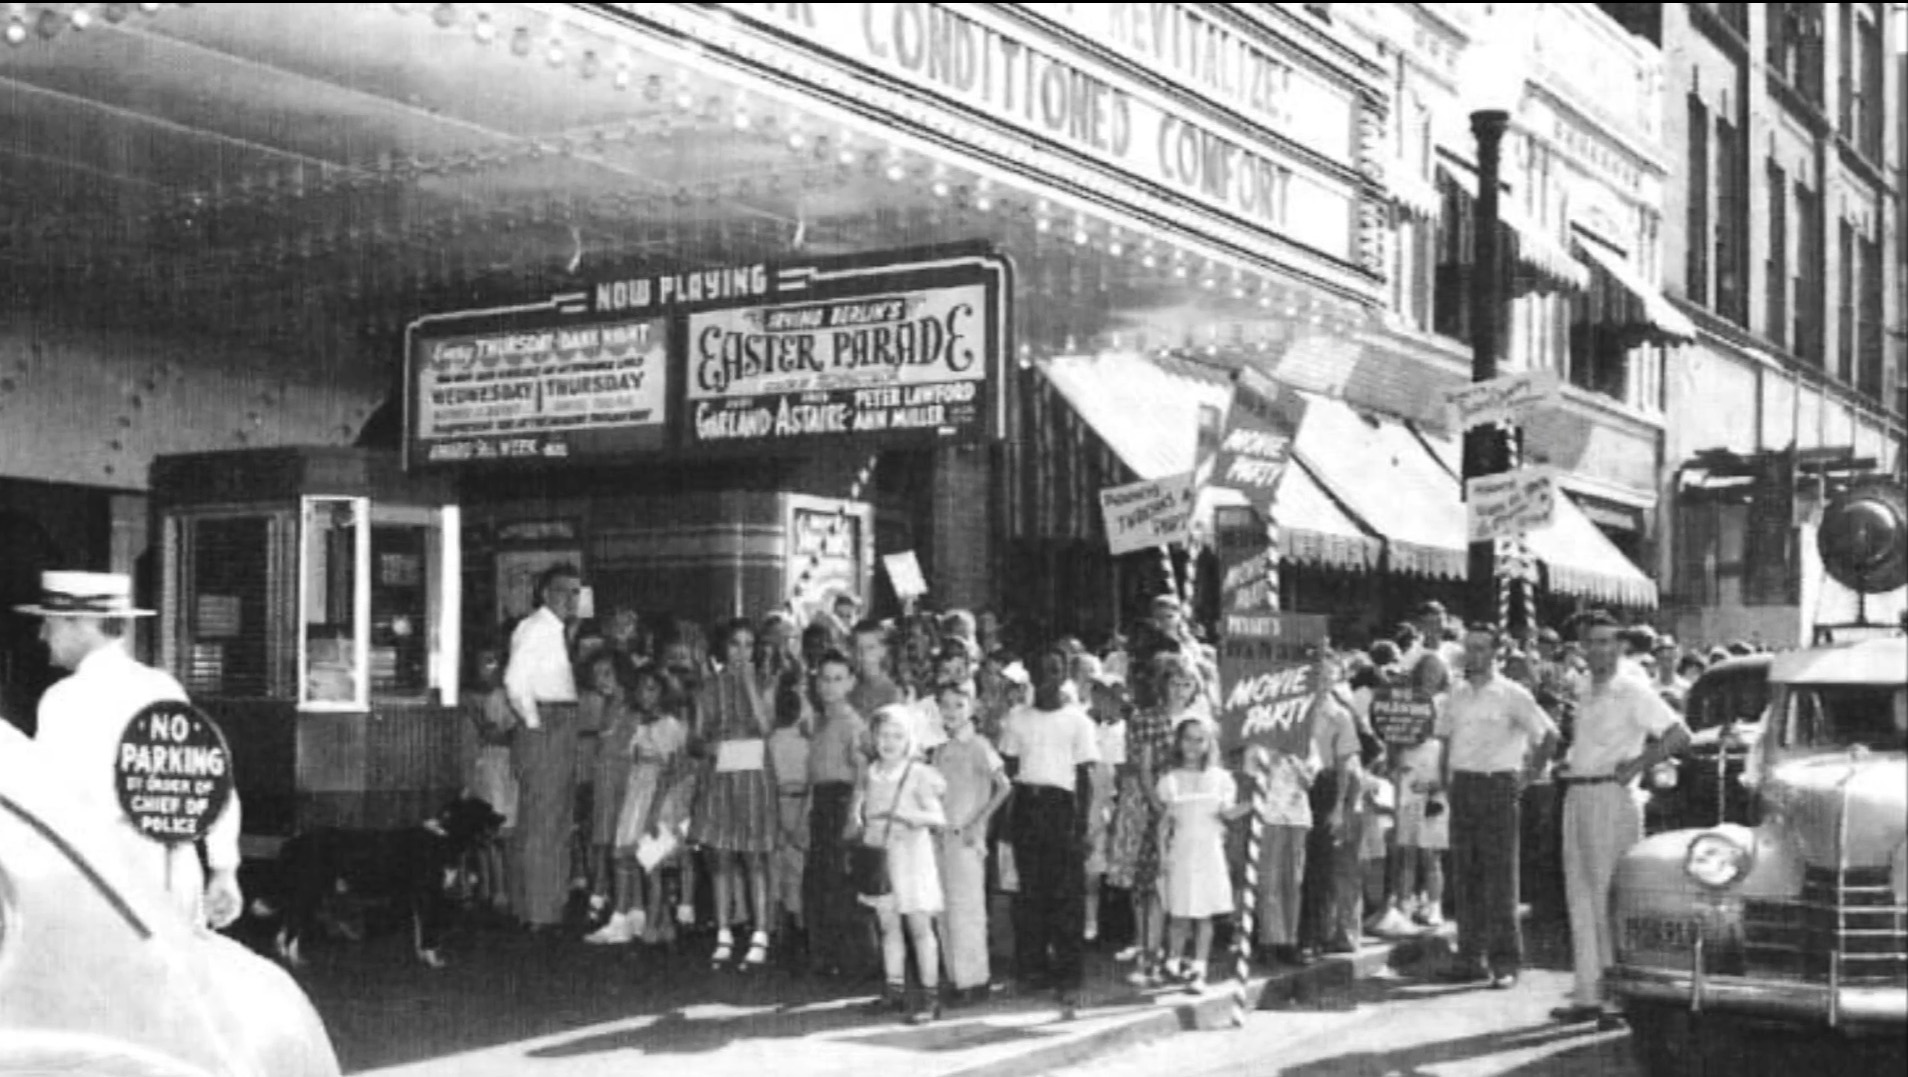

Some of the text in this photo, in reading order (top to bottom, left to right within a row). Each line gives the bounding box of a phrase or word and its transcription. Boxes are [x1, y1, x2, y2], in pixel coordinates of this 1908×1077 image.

[862, 4, 1293, 227] CONDITIONED COMFORT
[597, 264, 767, 311] NOW PLAYING
[699, 303, 974, 394] EASTER PARADE
[432, 382, 532, 405] WEDNESDAY
[546, 371, 645, 397] THURSDAY
[855, 388, 901, 408] PETER
[904, 381, 977, 406] LAWFORD
[1221, 428, 1290, 459] MOVIE
[1226, 456, 1284, 488] PARTY
[1226, 663, 1312, 711] MOVIE
[151, 713, 189, 742] NO
[1241, 692, 1316, 739] PARTY
[121, 742, 225, 777] PARKING
[130, 796, 209, 816] CHIEF OF
[142, 815, 198, 834] POLICE
